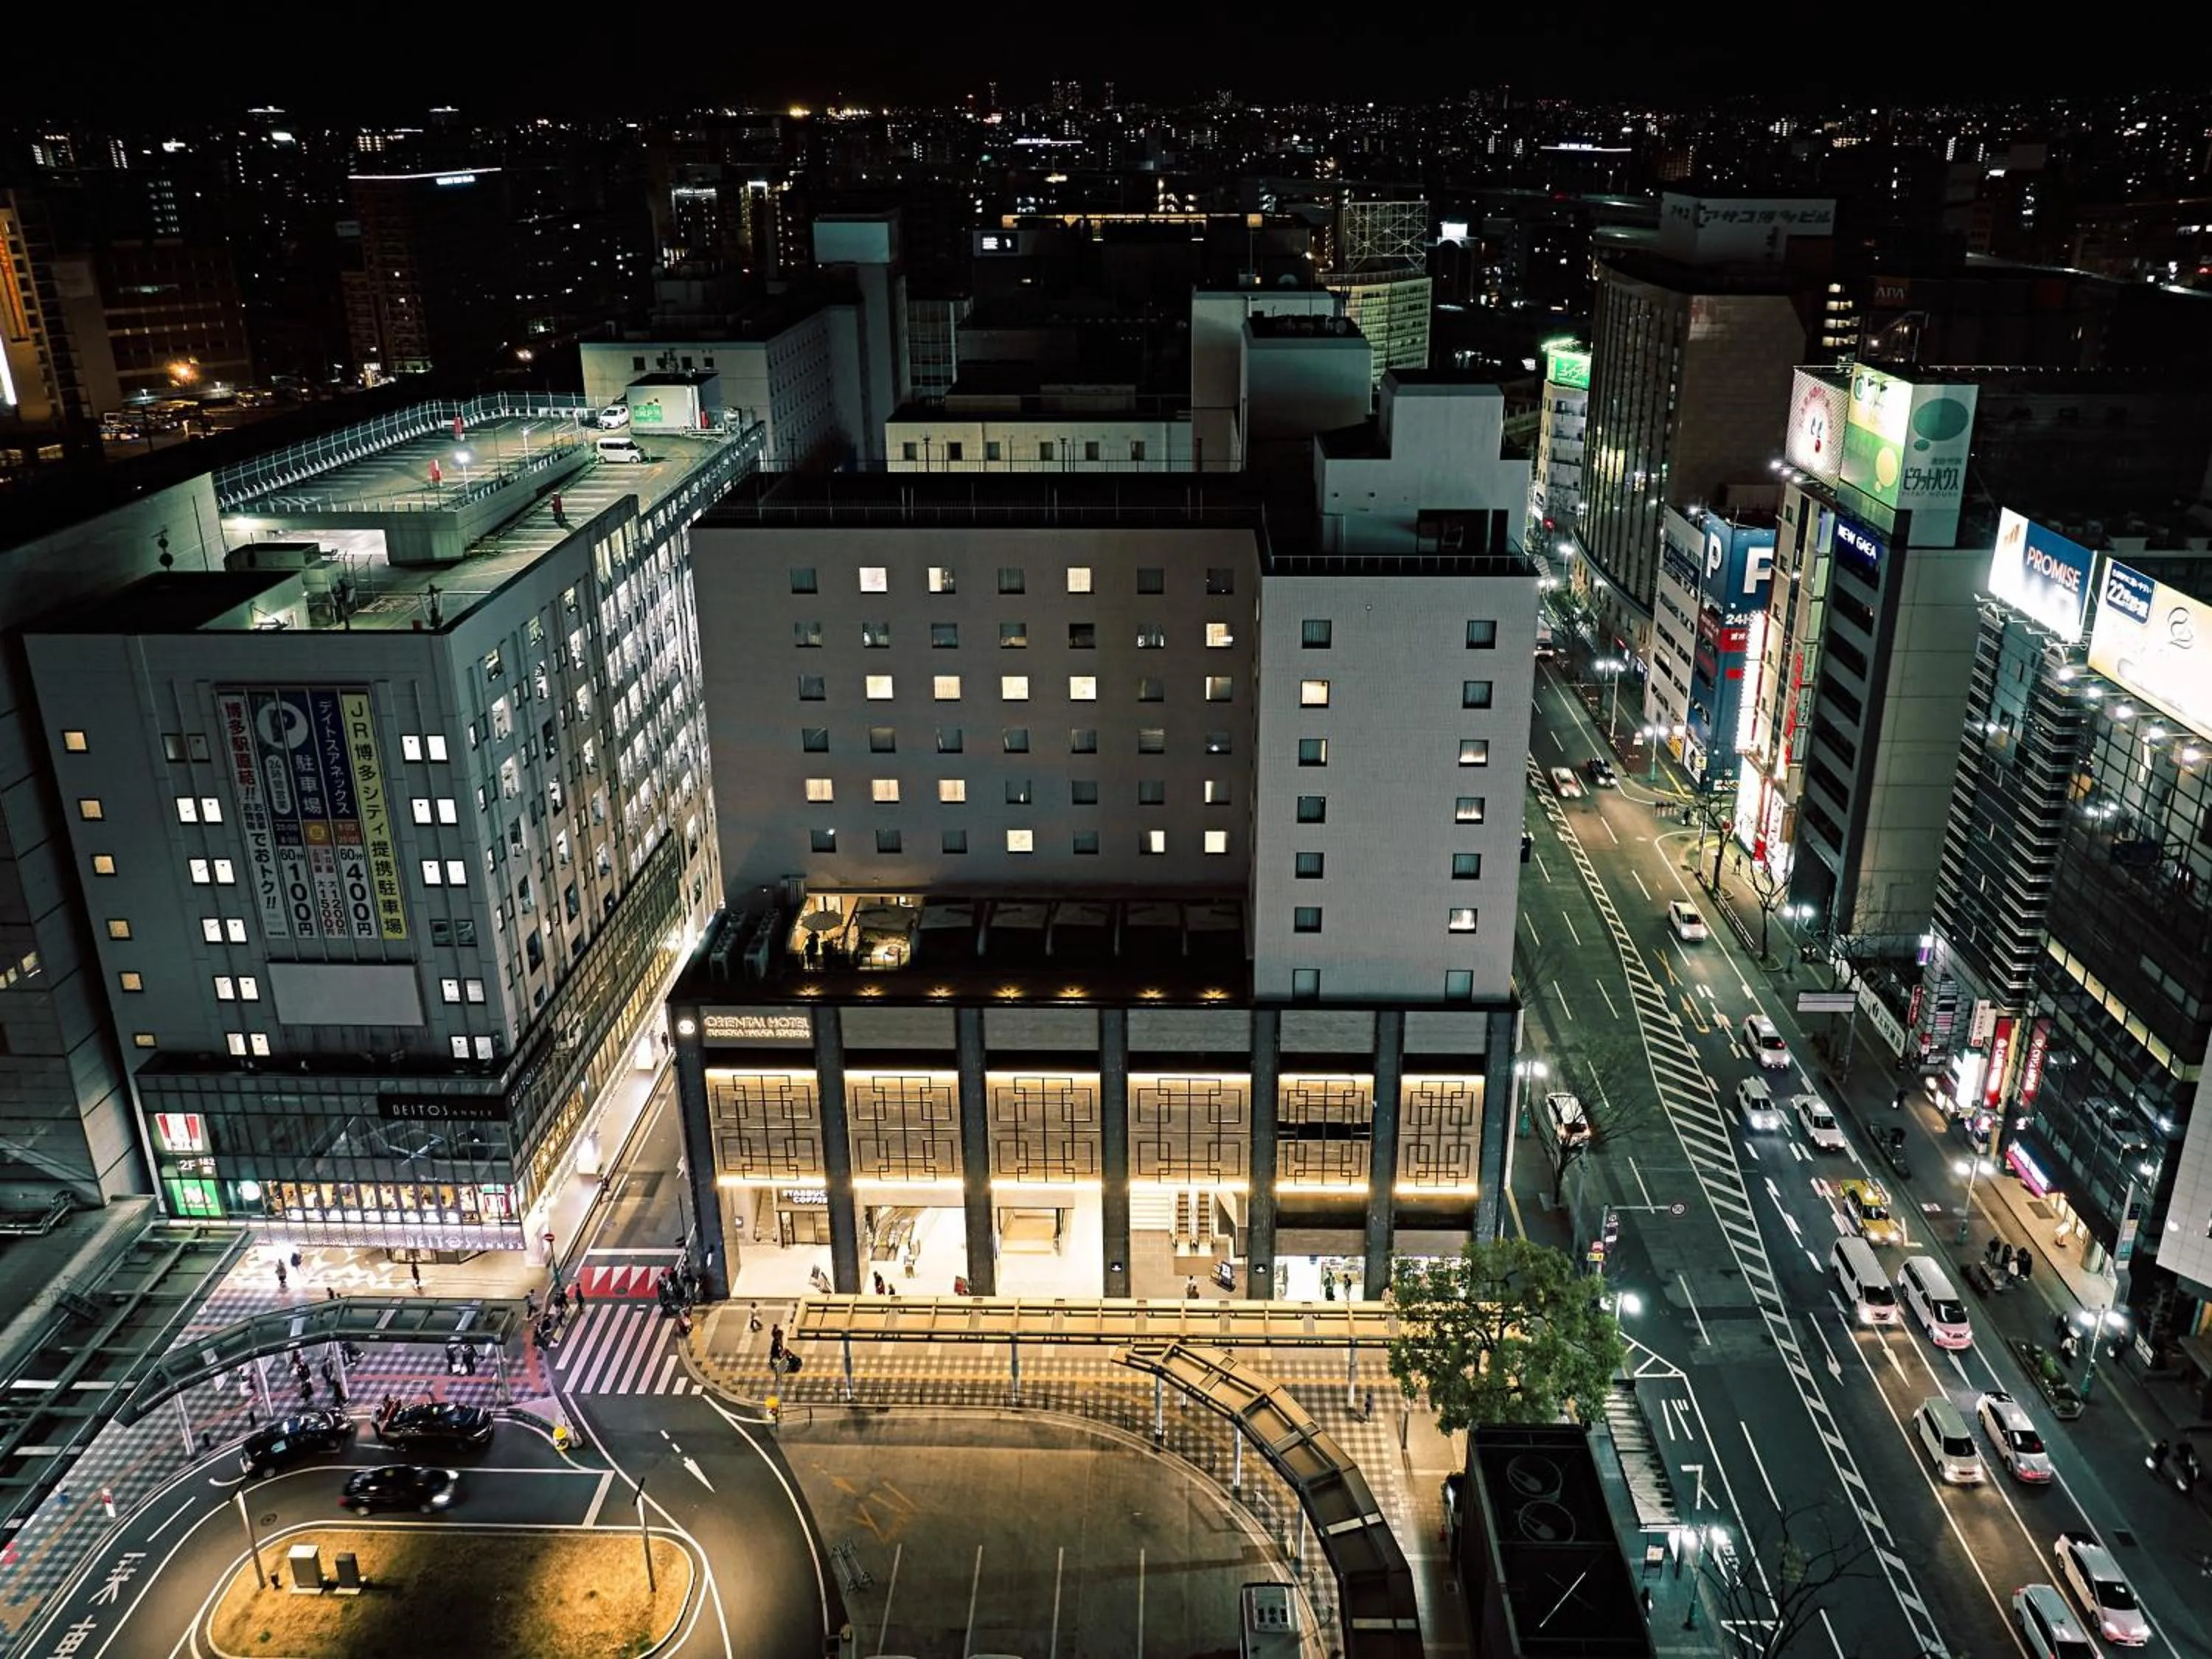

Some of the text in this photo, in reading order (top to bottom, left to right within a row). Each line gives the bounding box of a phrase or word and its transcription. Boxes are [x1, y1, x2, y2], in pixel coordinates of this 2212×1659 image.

[1705, 531, 1722, 580] P
[1838, 523, 1857, 545] NEW
[2027, 545, 2082, 593] PROMISE
[294, 754, 323, 815] 駐車場
[346, 863, 373, 936] 400円
[179, 1160, 196, 1171] 2F
